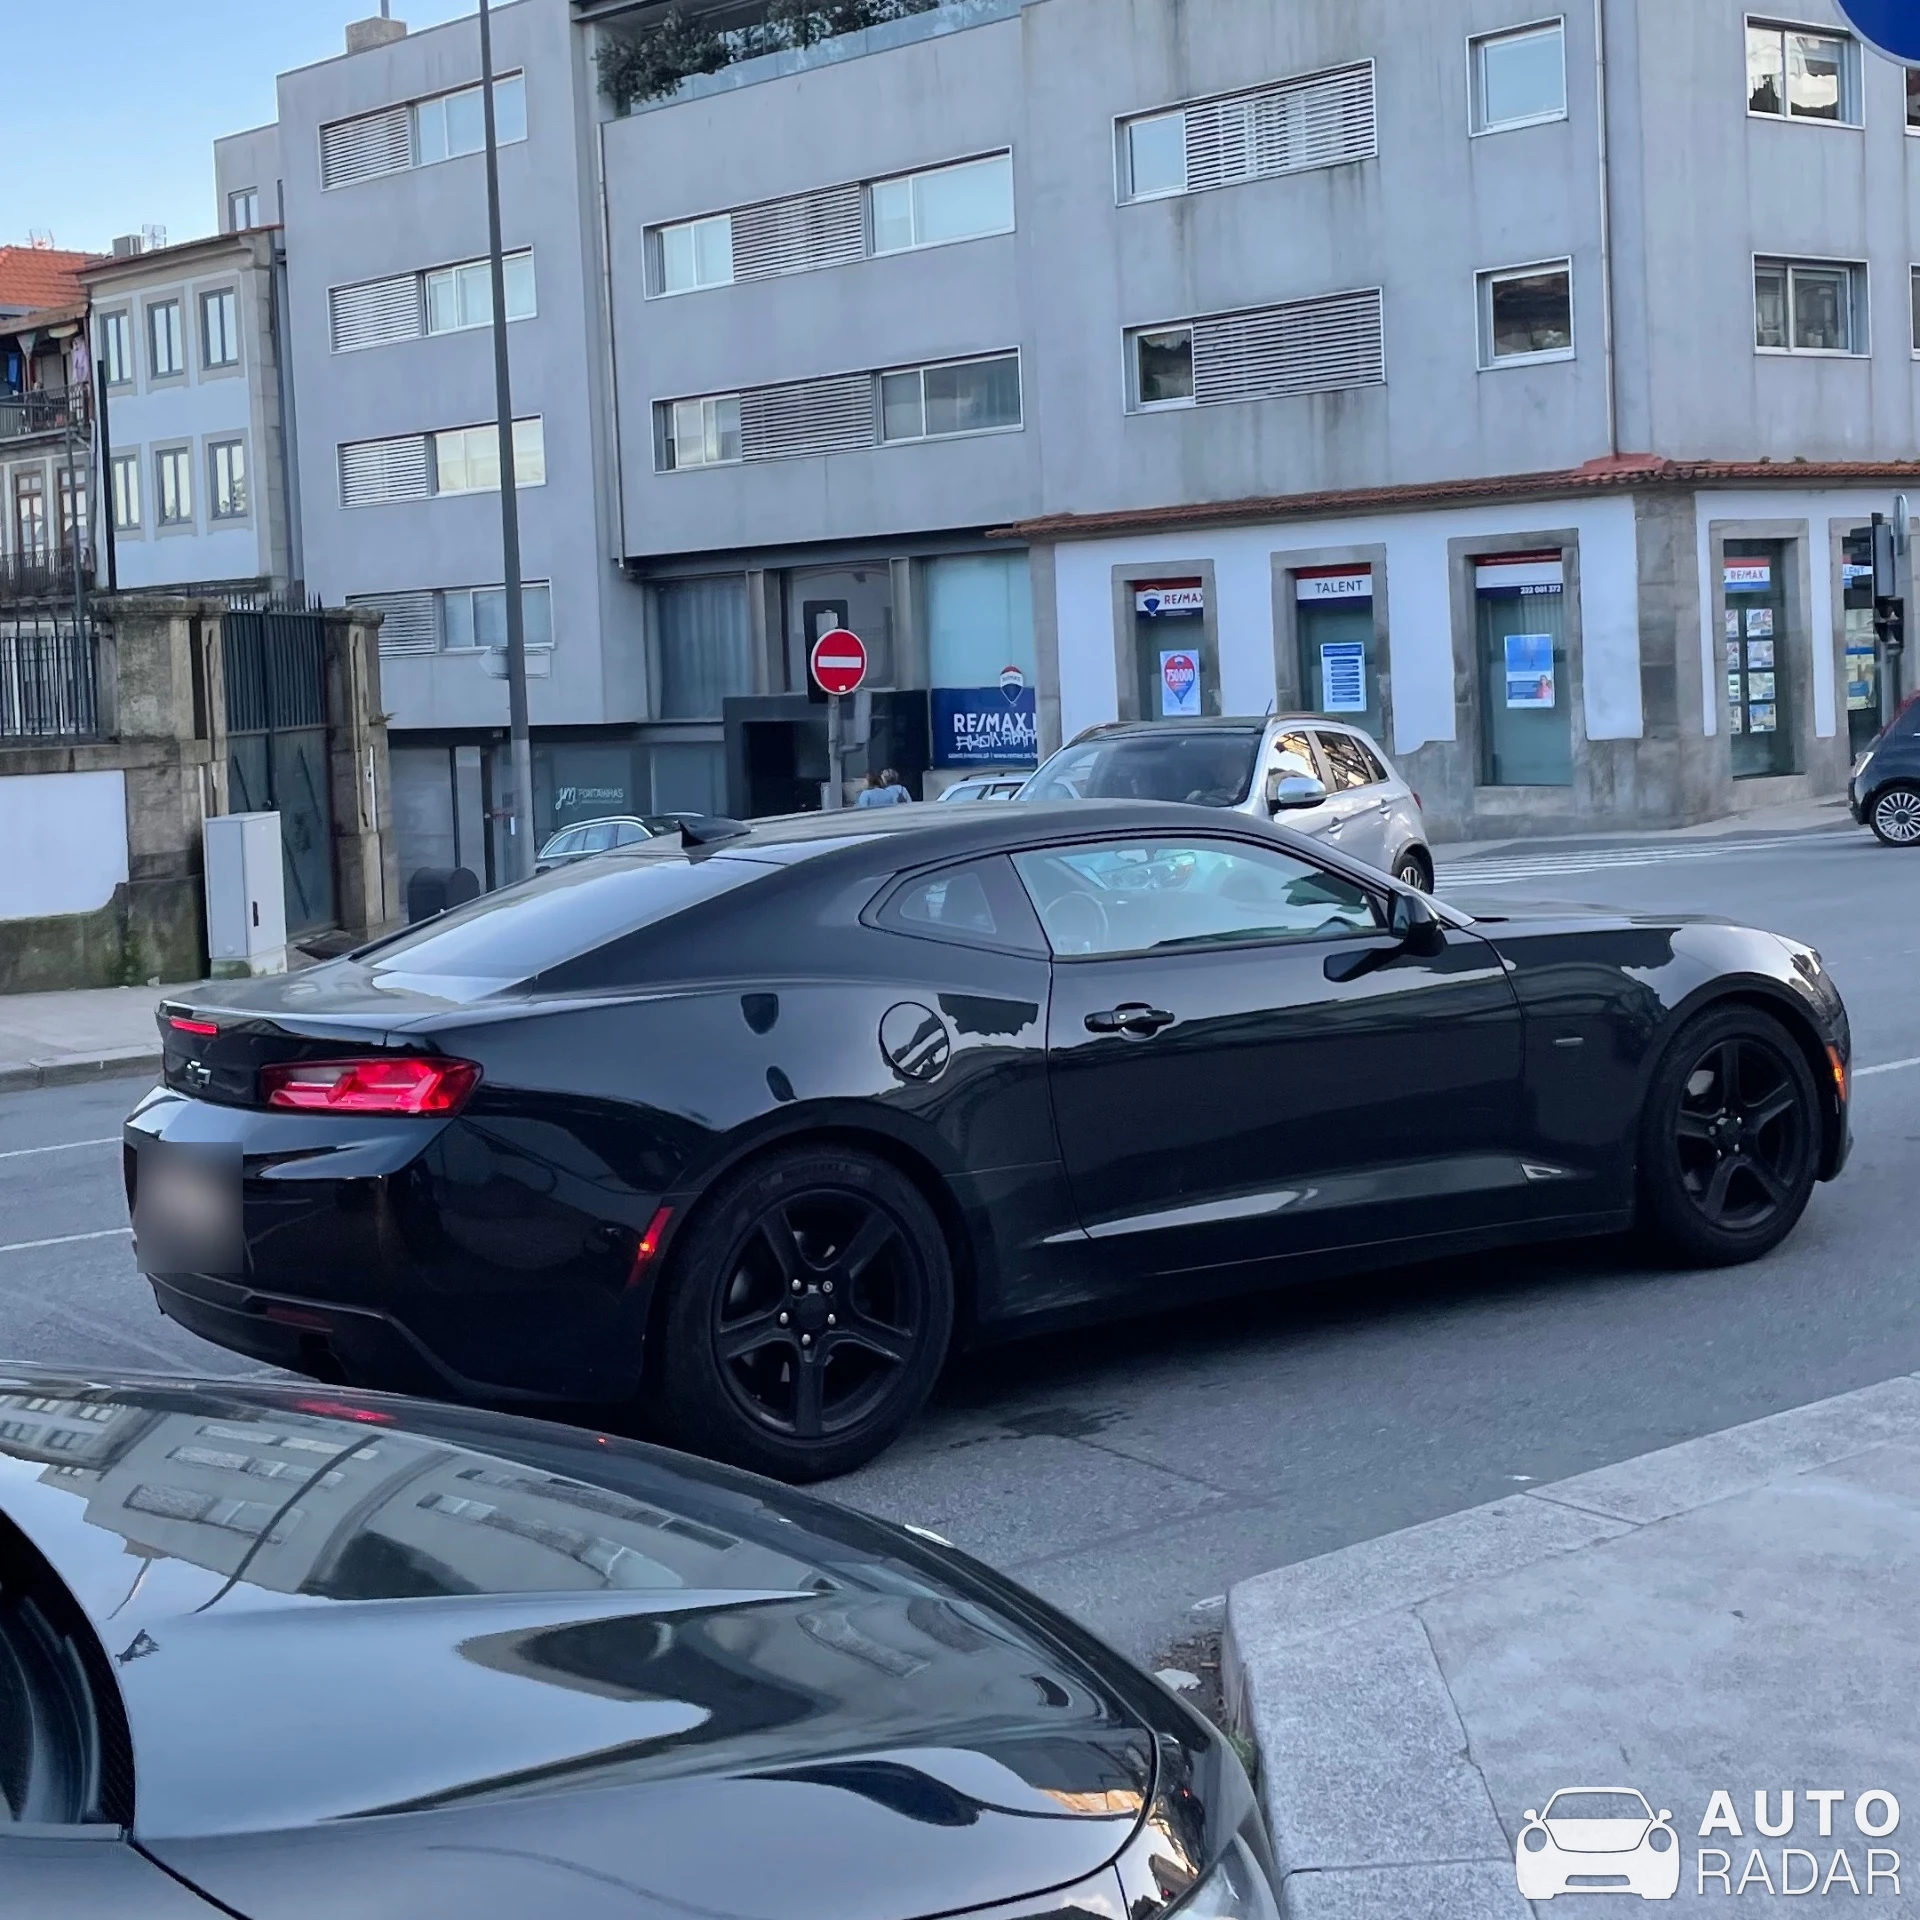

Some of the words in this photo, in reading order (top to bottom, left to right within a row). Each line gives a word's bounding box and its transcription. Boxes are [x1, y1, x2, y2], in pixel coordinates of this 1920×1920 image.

[1730, 570, 1764, 580] RE/MAX
[1315, 580, 1363, 594] TALENT
[953, 712, 1027, 733] RE/MAX
